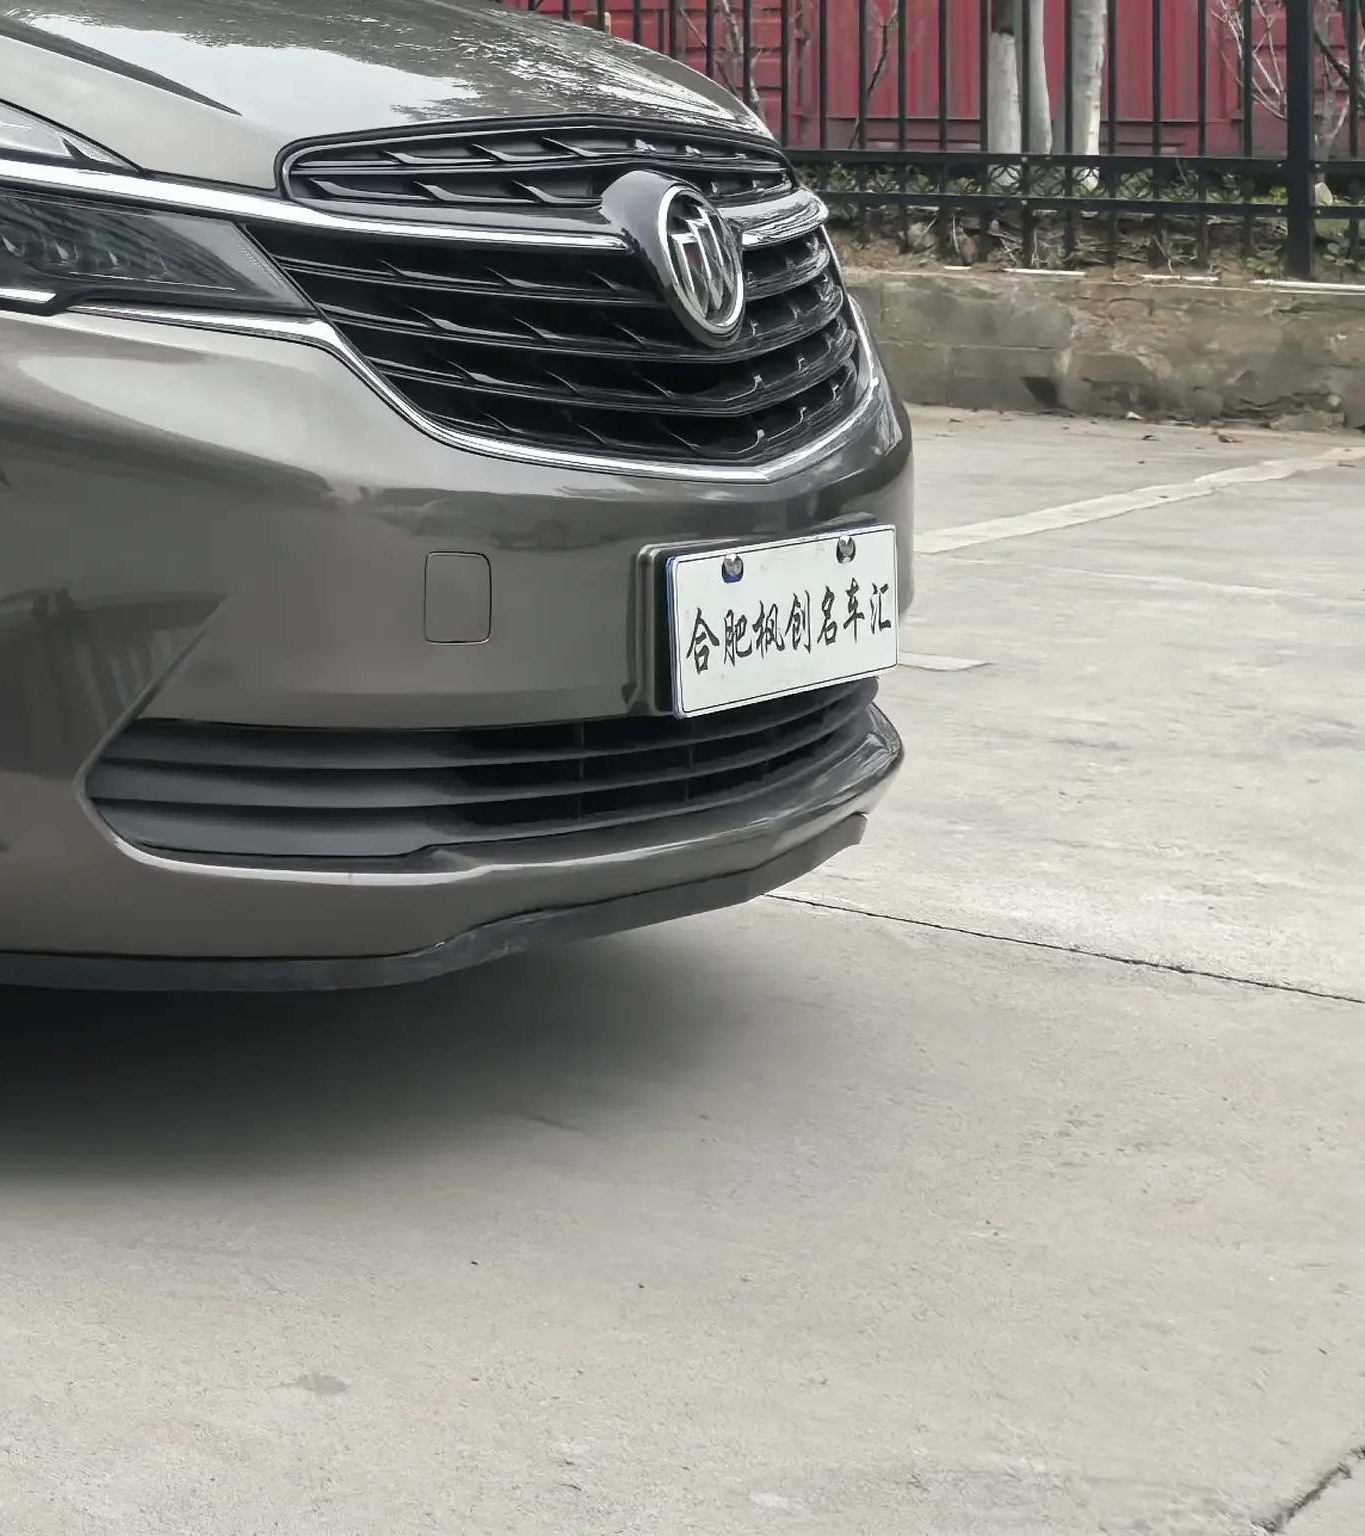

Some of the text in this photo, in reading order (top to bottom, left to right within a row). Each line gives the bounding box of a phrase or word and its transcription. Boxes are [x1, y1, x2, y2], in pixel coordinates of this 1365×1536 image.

[686, 577, 891, 674] 合肥枫创名车汇
